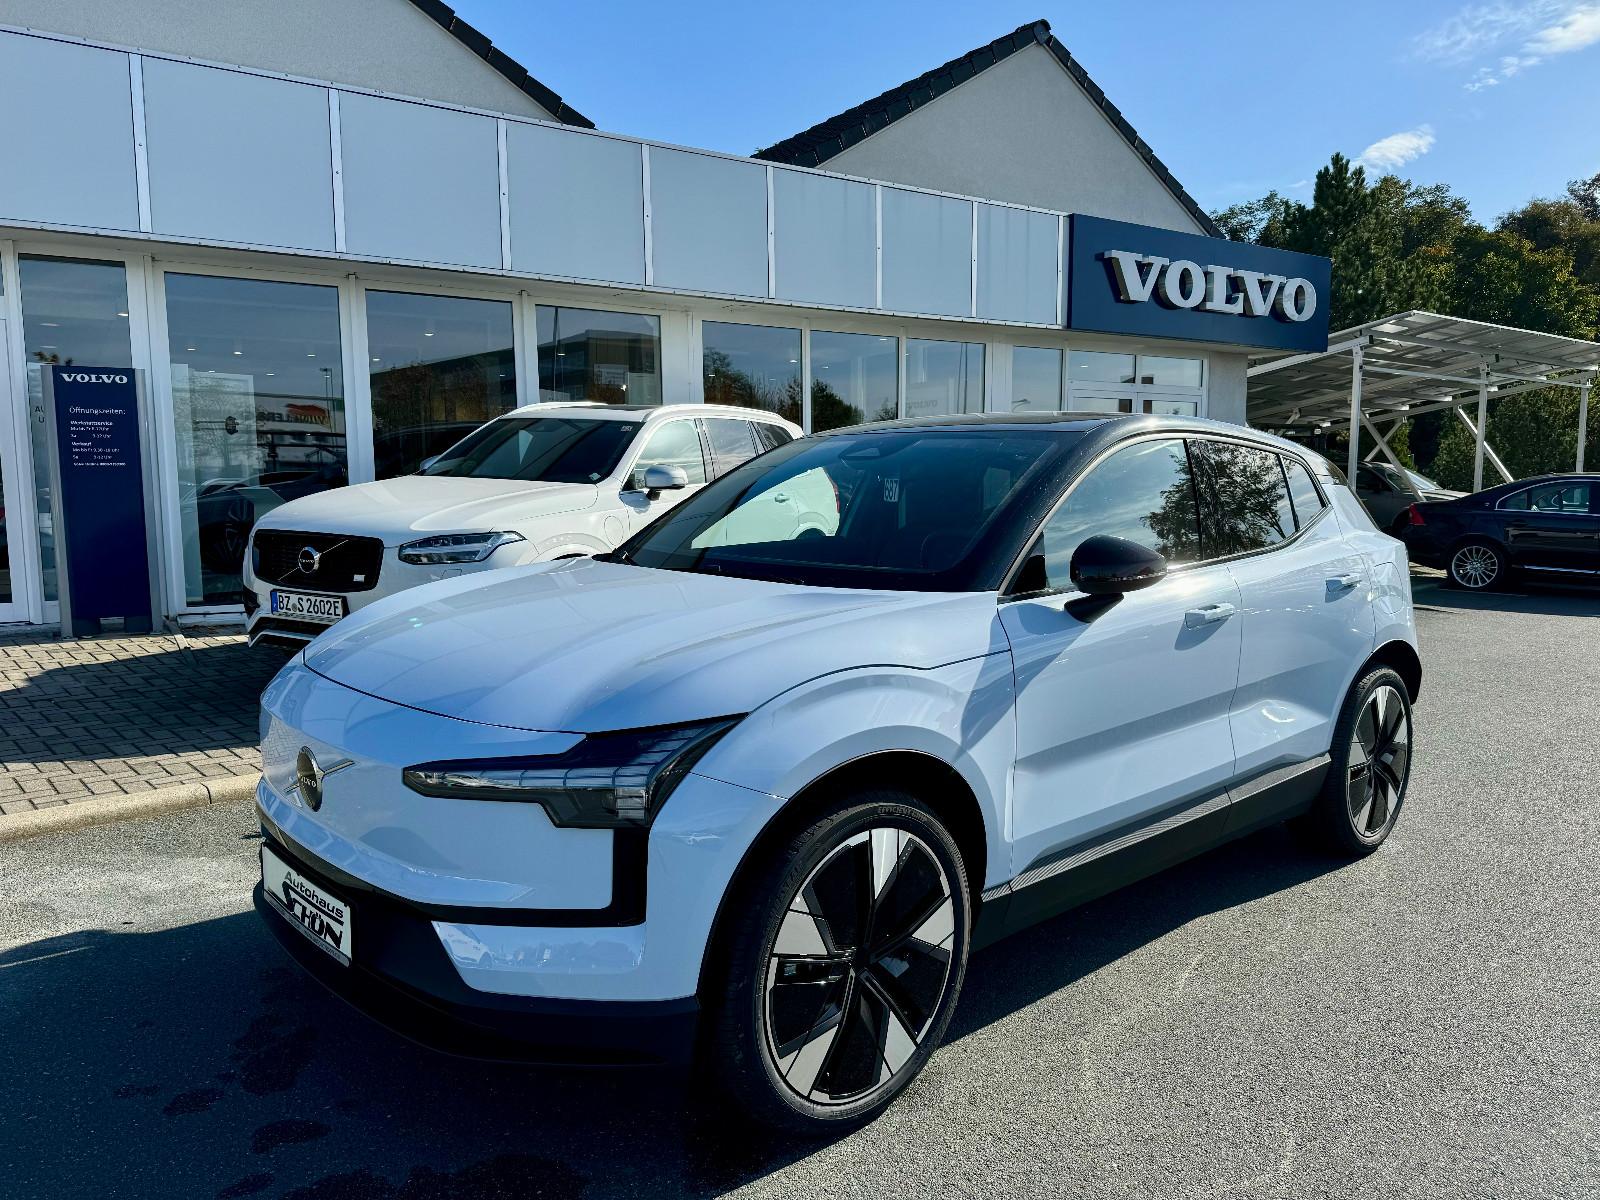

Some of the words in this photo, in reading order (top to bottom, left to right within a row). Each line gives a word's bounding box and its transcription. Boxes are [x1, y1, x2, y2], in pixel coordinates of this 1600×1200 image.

[1102, 250, 1317, 322] VOLVO
[60, 373, 128, 384] VOLVO
[278, 595, 291, 612] BZ
[297, 597, 304, 613] S
[306, 599, 341, 617] 2602E
[284, 871, 344, 919] Autohaus
